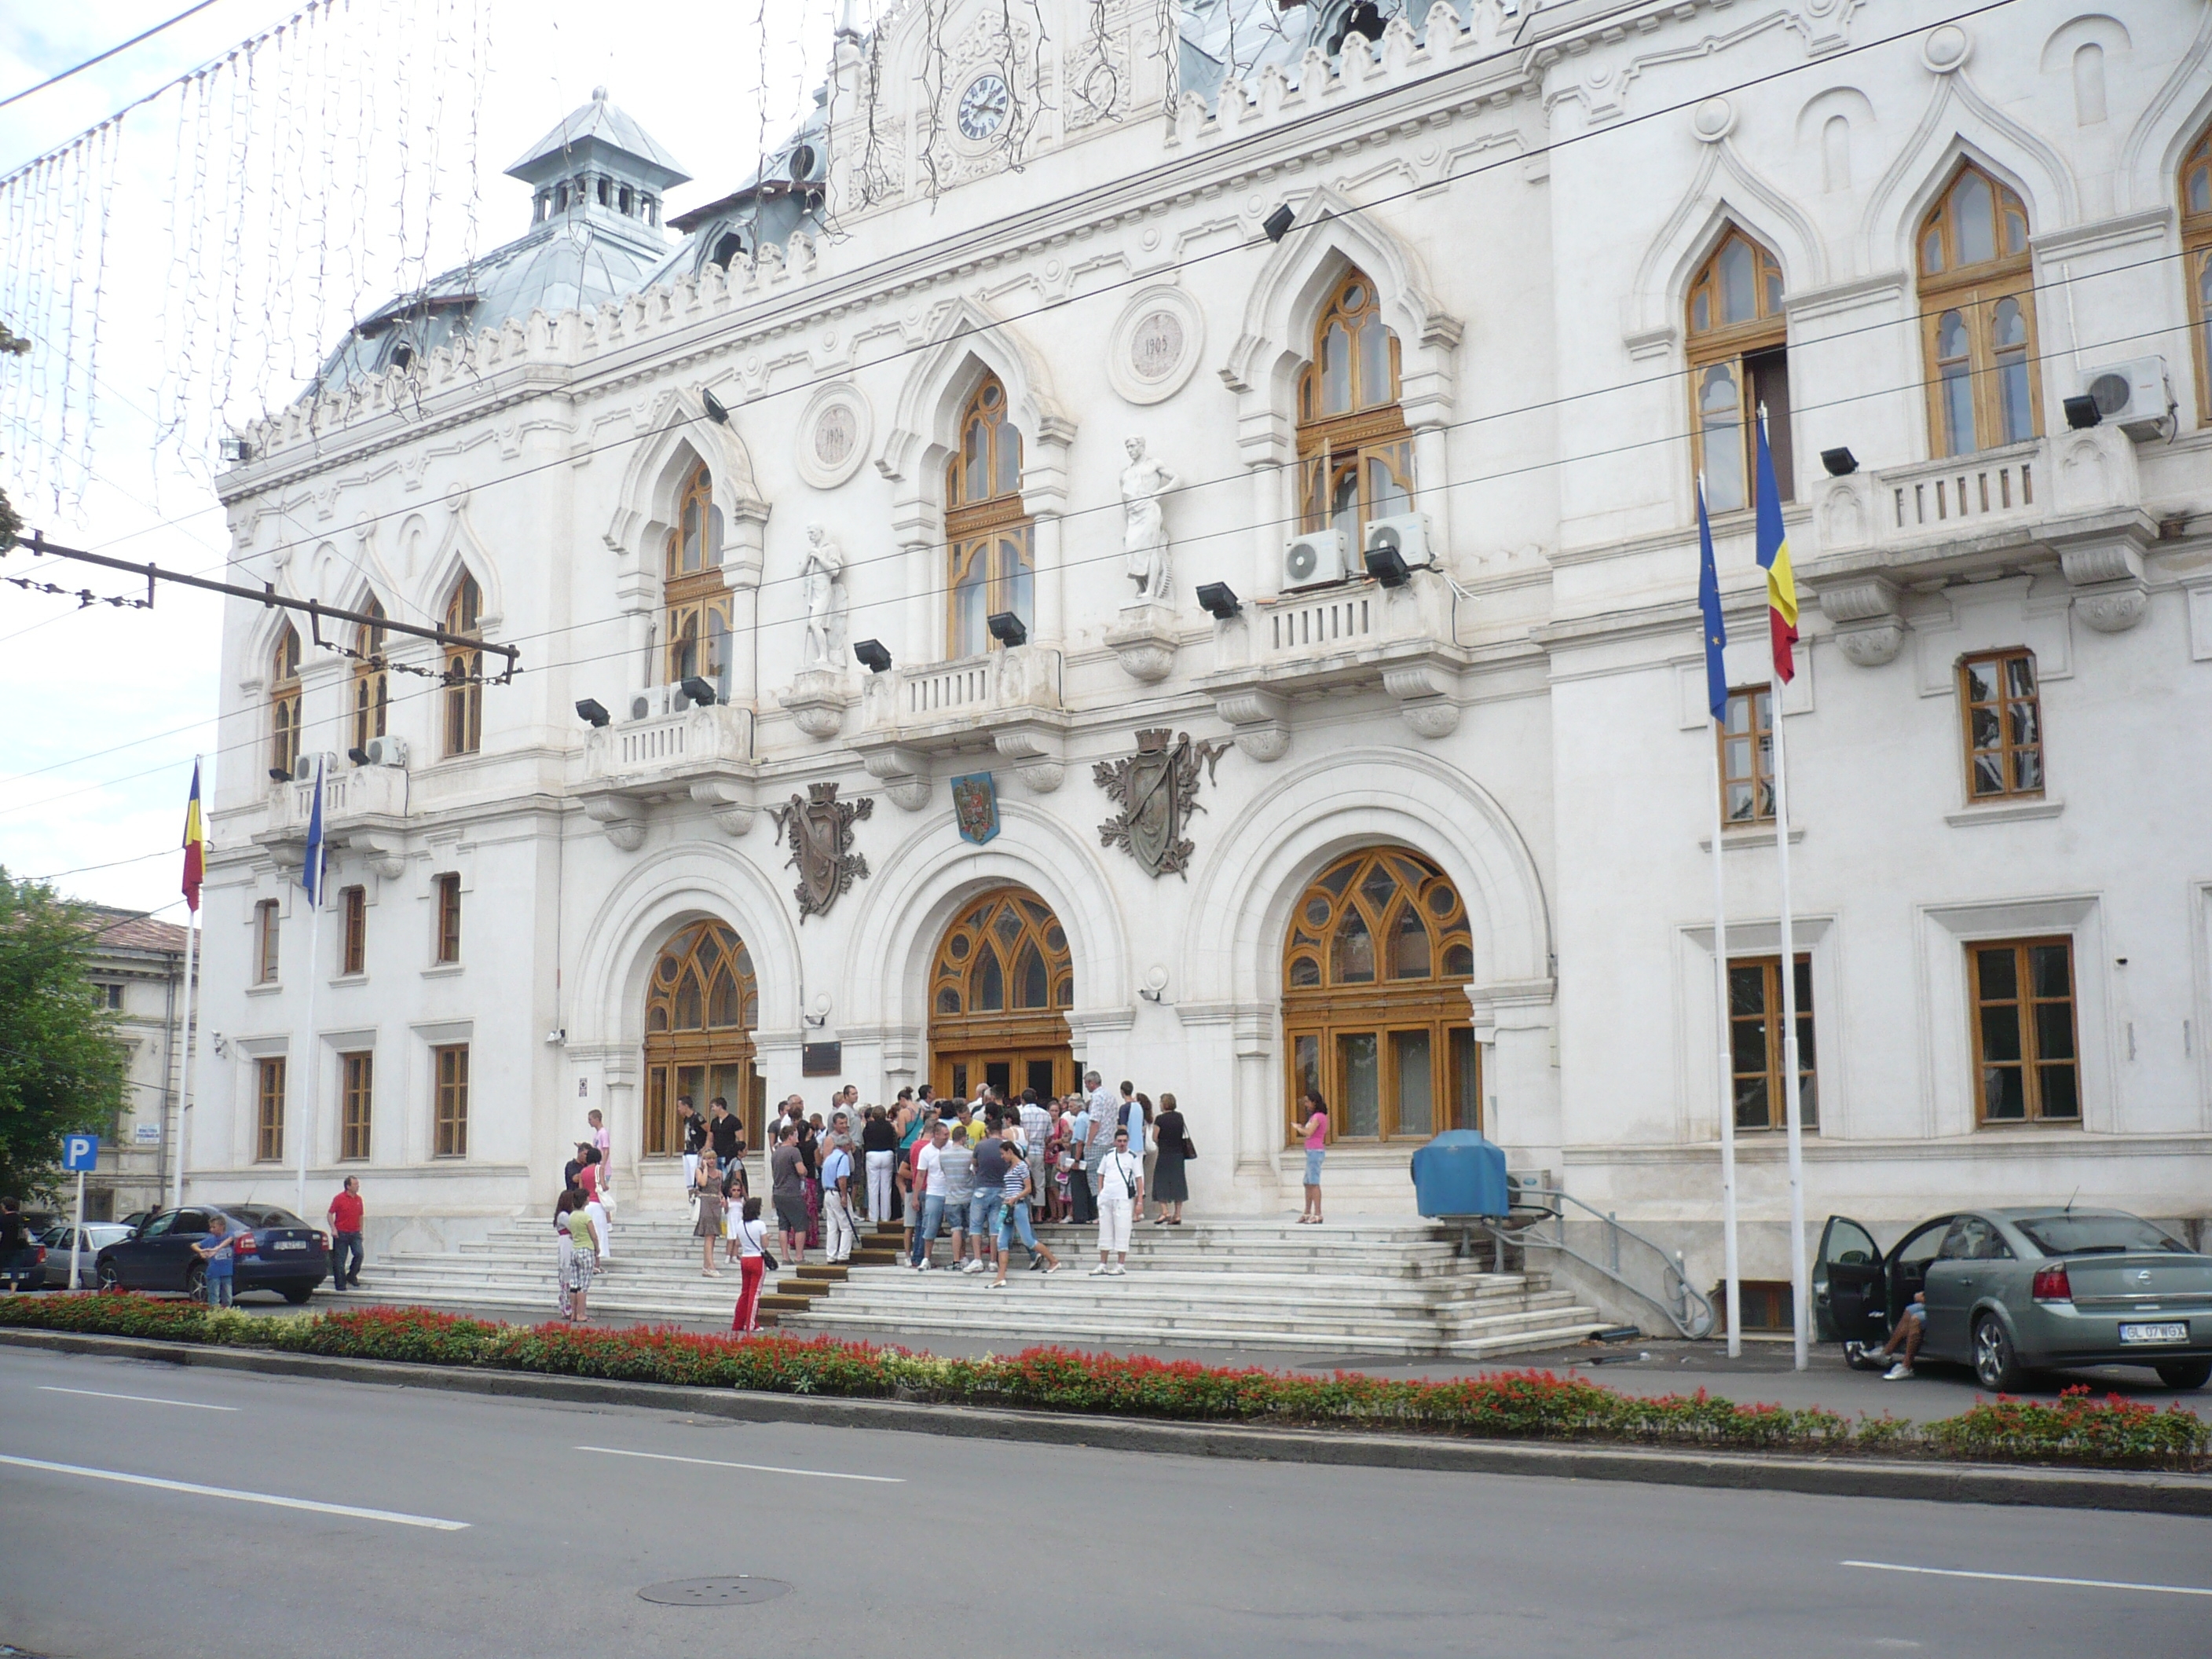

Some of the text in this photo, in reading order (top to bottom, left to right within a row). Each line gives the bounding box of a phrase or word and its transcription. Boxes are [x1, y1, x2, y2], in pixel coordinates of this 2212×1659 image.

[1146, 335, 1167, 355] 1905
[827, 427, 844, 445] 1904
[70, 1139, 90, 1166] P
